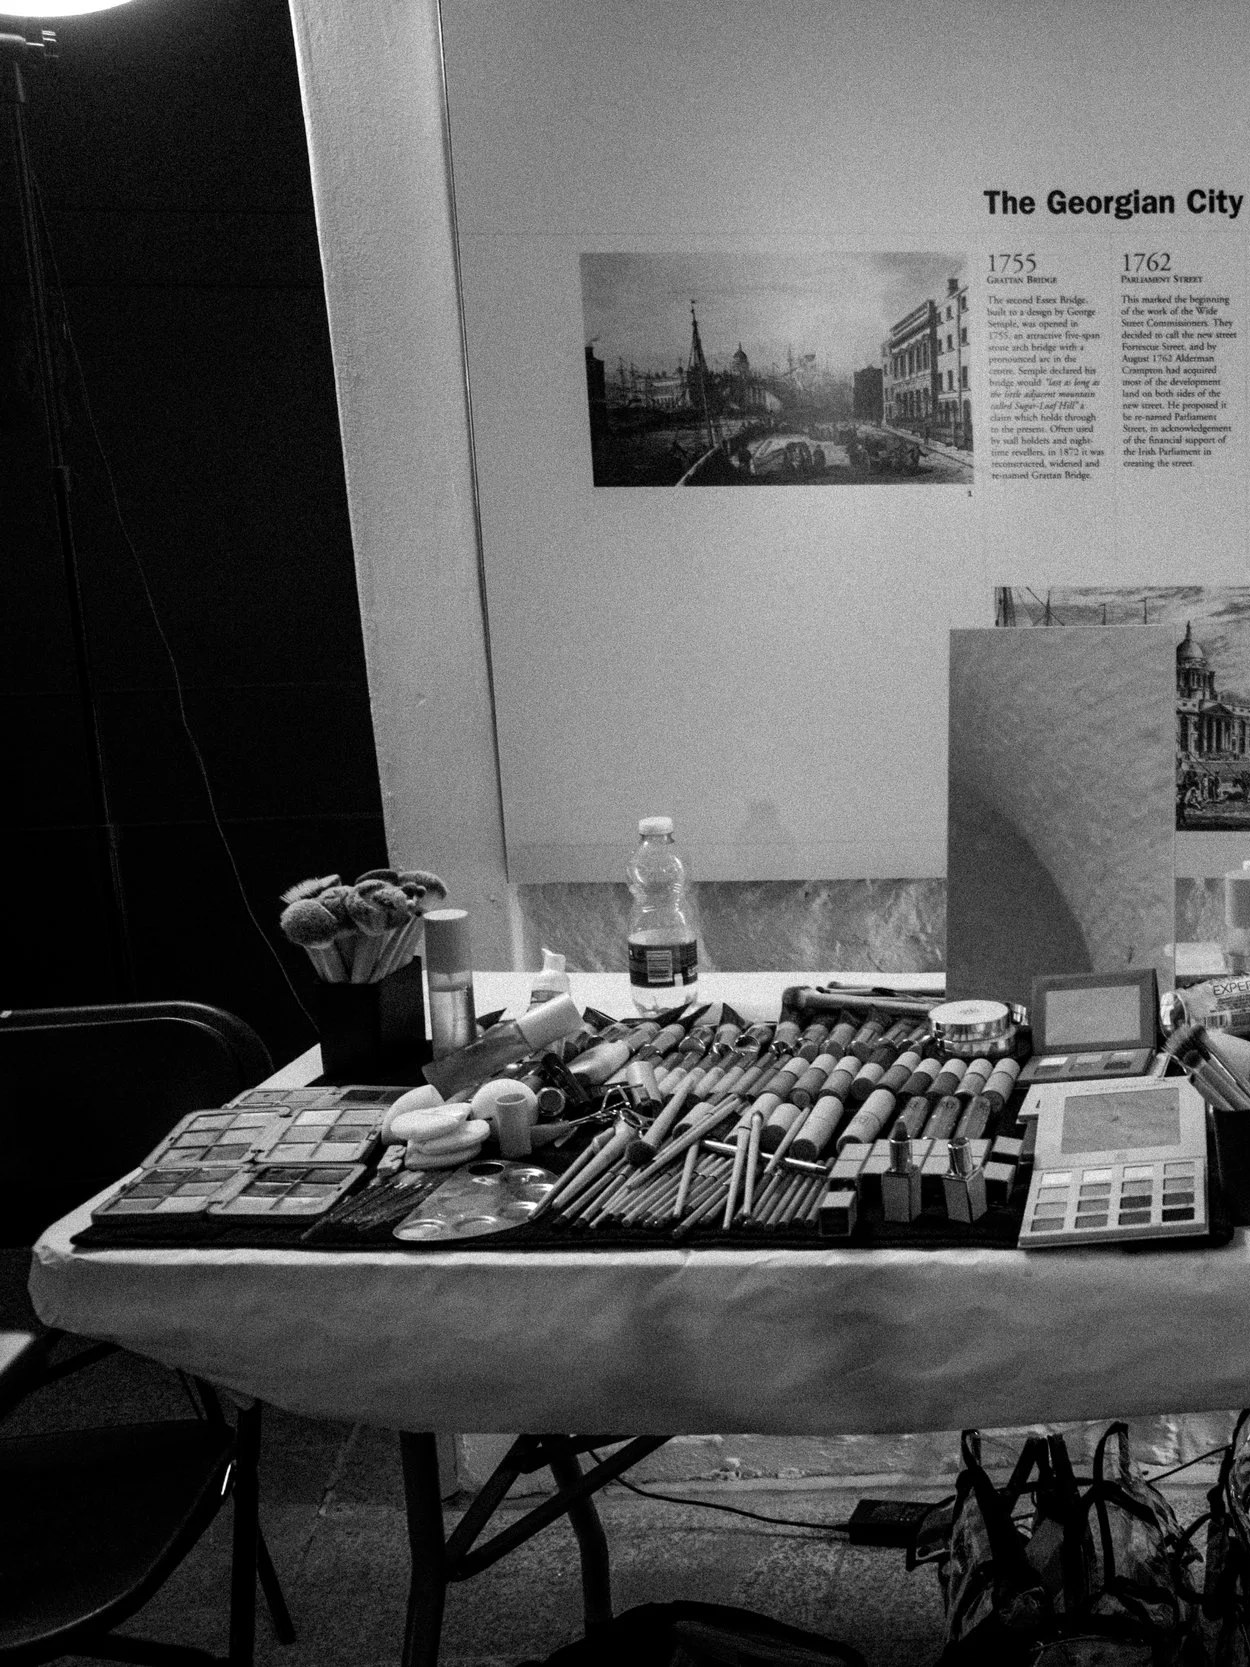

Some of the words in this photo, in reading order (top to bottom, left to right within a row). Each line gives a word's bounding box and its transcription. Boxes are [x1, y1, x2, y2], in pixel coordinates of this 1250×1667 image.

[983, 190, 1035, 215] The
[1046, 189, 1175, 221] Georgian
[1186, 189, 1244, 220] City
[988, 253, 1037, 274] 1755
[1123, 252, 1171, 273] 1762
[1122, 295, 1139, 304] This
[1141, 295, 1172, 304] marked
[1174, 295, 1187, 304] the
[1189, 295, 1230, 307] beginning
[1122, 354, 1150, 366] August
[1153, 354, 1173, 363] 1762
[1176, 354, 1215, 363] Alderman
[1122, 412, 1132, 421] be
[1134, 412, 1172, 421] re-named
[1174, 412, 1217, 421] Parliament
[1123, 435, 1132, 444] of
[1133, 435, 1146, 444] the
[1148, 435, 1183, 444] financial
[1185, 435, 1216, 447] support
[1218, 435, 1227, 444] of
[1123, 447, 1136, 456] the
[1138, 447, 1156, 456] Irish
[1158, 447, 1201, 456] Parliament
[1203, 447, 1212, 456] in
